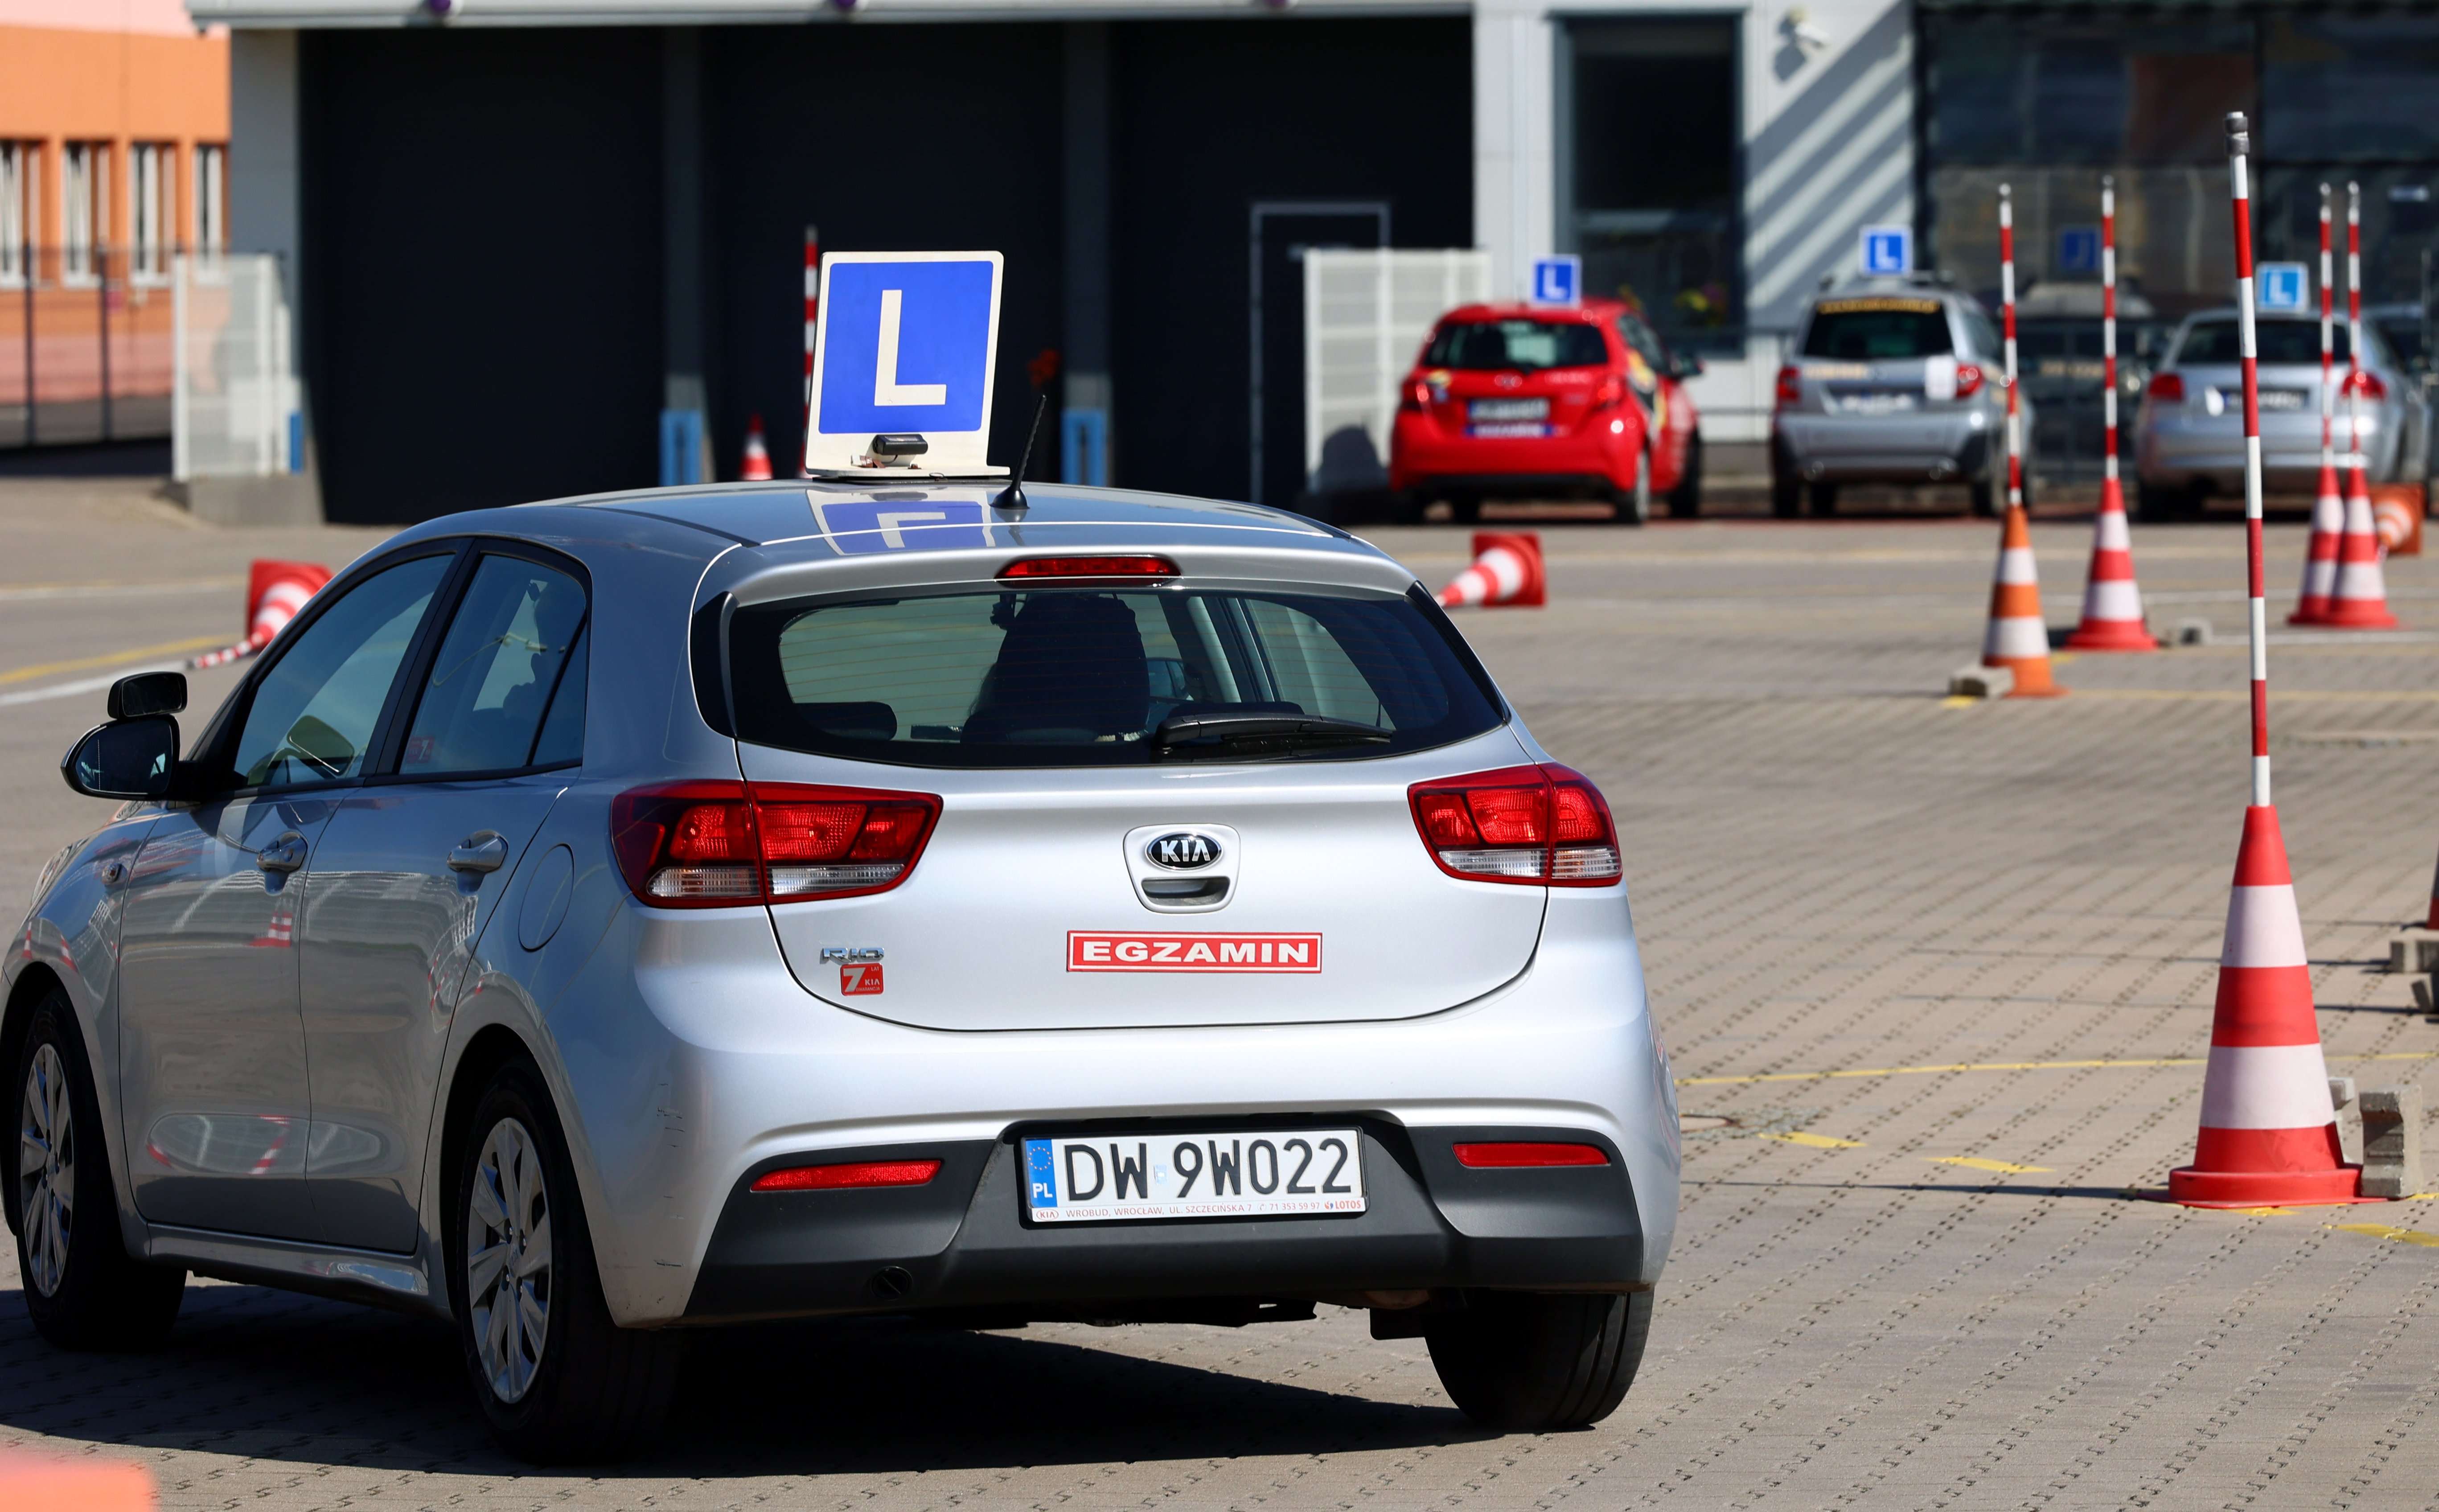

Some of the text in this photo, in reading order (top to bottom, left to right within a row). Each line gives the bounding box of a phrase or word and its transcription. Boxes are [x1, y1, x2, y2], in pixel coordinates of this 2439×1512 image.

[1874, 238, 1900, 270] L
[1544, 267, 1567, 300] L
[2270, 274, 2291, 305] L
[874, 289, 947, 407] L
[1159, 839, 1211, 863] KIA
[822, 948, 885, 962] RIO
[1083, 941, 1309, 963] EGZAMIN
[843, 967, 866, 992] 7
[864, 978, 880, 986] KIA
[1063, 1138, 1352, 1201] DW 9W022
[1032, 1183, 1053, 1199] PL
[1066, 1208, 1111, 1217] WROBUD,
[1114, 1206, 1165, 1216] WROCŁAW,
[1169, 1205, 1183, 1214] UL.
[1185, 1202, 1245, 1213] SZCZECIŃSKA
[1310, 1202, 1320, 1210] 97
[1335, 1200, 1362, 1209] LOTOS
